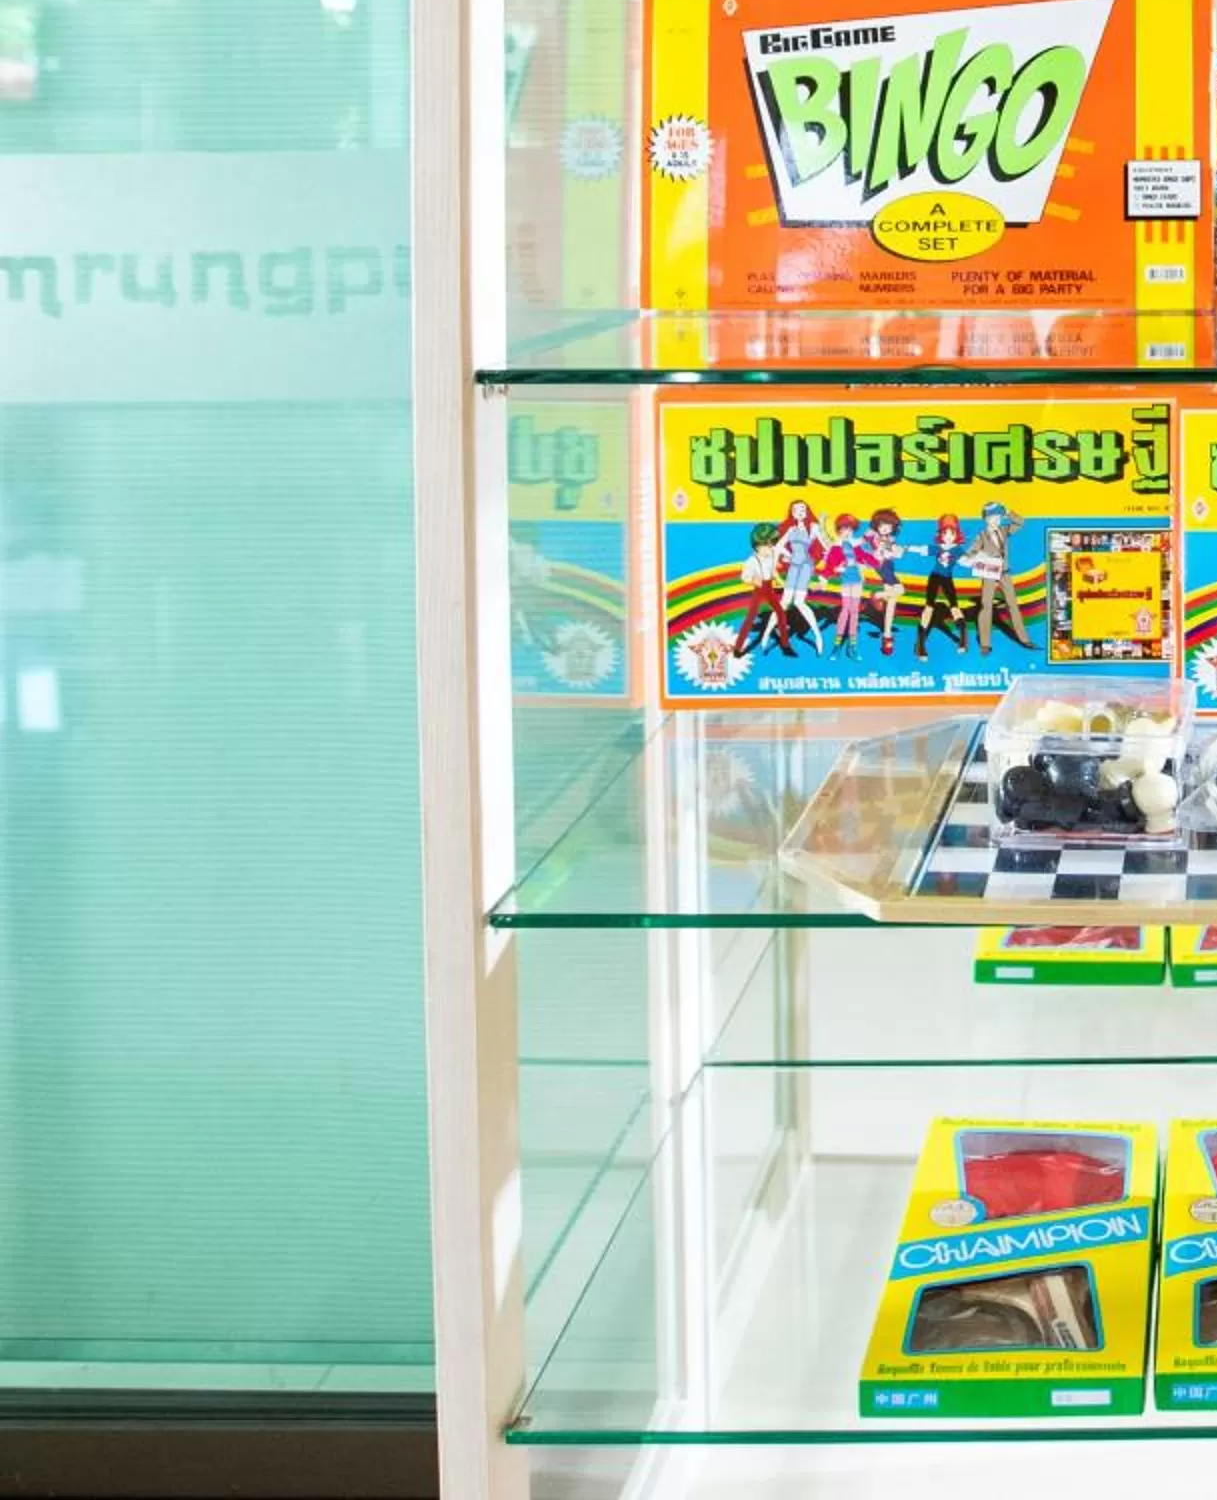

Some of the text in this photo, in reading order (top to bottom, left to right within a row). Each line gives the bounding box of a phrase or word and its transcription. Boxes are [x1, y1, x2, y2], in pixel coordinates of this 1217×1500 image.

[758, 27, 1087, 203] BINGO
[930, 203, 946, 216] A
[879, 220, 998, 233] COMPLETE
[918, 237, 958, 251] SET
[951, 270, 1095, 281] PLENTY OF MATERIAL
[963, 284, 1082, 295] FOR A BIG PARTY
[900, 1213, 1142, 1269] CHAMPION
